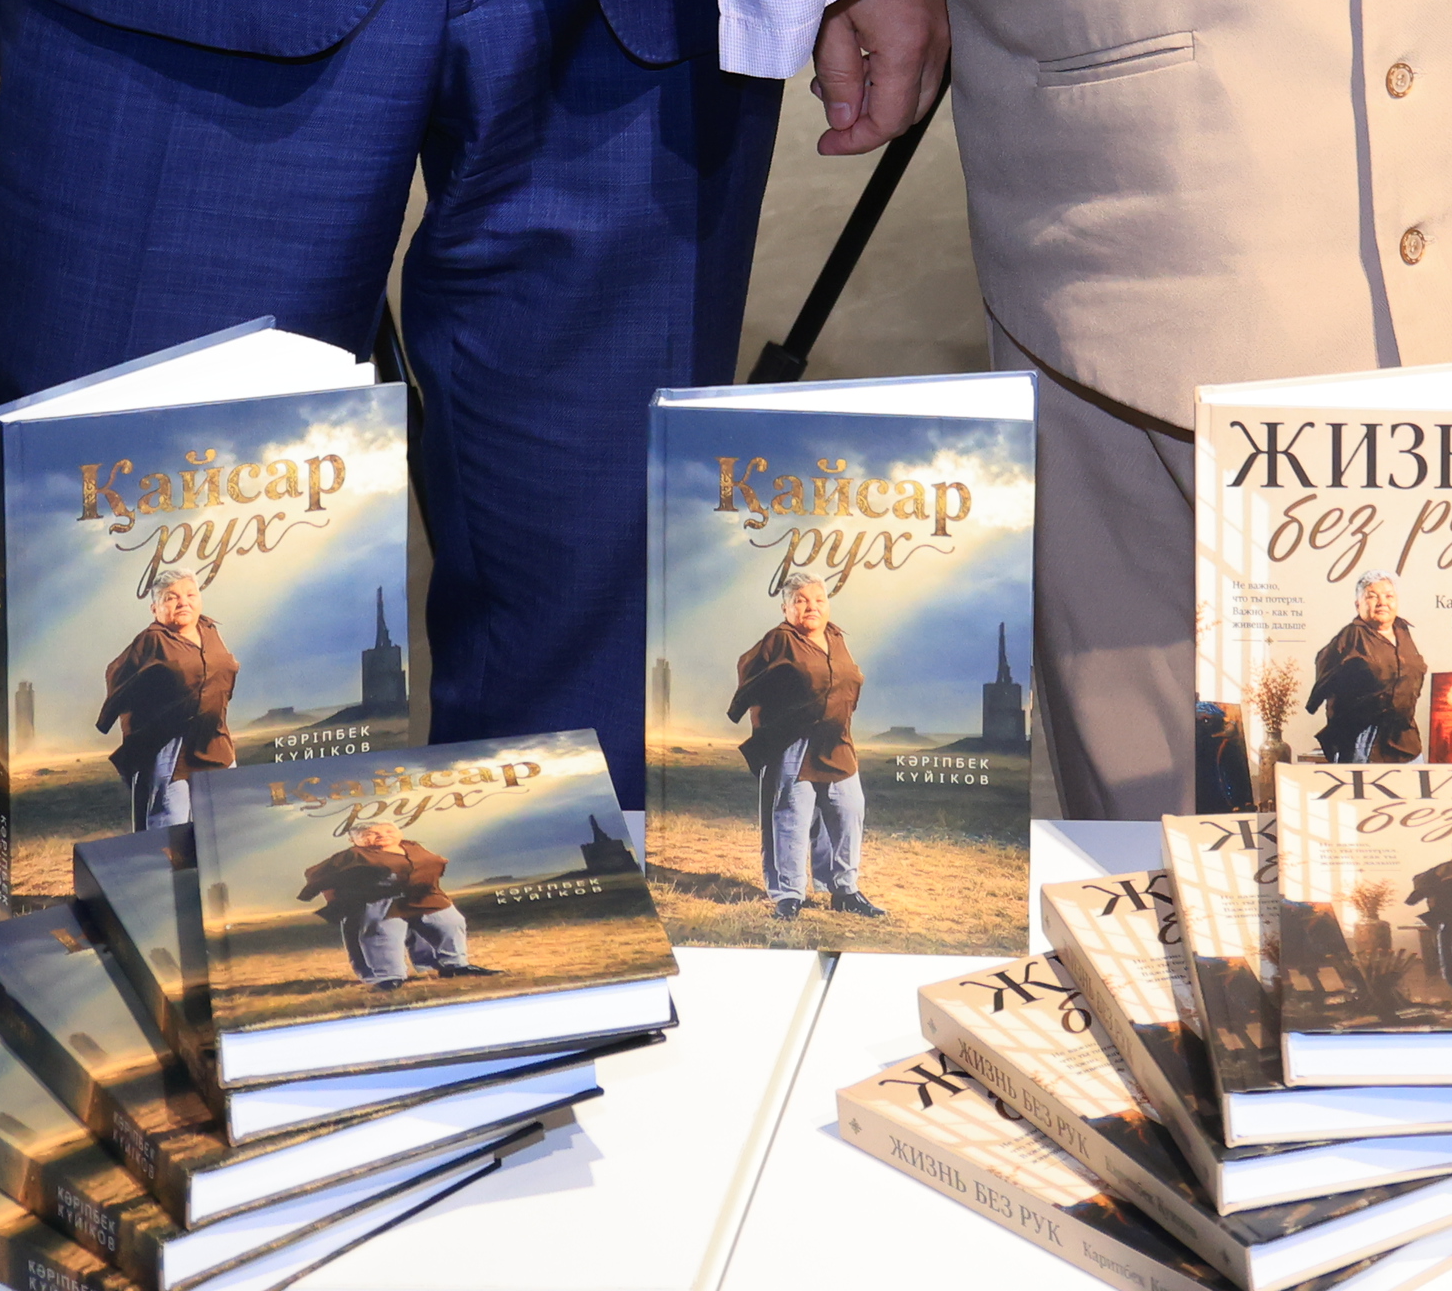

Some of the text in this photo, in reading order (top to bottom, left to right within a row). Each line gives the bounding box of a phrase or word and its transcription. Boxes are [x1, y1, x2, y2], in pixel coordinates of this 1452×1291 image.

[76, 448, 346, 536] Қайсар
[713, 456, 972, 537] Қайсар
[1267, 493, 1384, 583] без
[115, 512, 331, 600] рух
[749, 525, 955, 598] рух
[1232, 580, 1246, 590] Не
[1232, 594, 1305, 606] что ты потерял.
[1232, 606, 1264, 617] Важно
[1271, 608, 1289, 617] как
[1291, 608, 1303, 617] ты
[1232, 620, 1306, 631] живешь дальше
[275, 725, 370, 749] КӘРІПБЕК
[275, 742, 370, 764] КҮЙІКОВ
[896, 754, 990, 770] КӘРІПБЕК
[896, 770, 990, 786] КҮЙІКОВ
[307, 789, 530, 838] рух
[958, 1038, 1017, 1100] ЖИЗНЬ
[1021, 1087, 1053, 1128] БЕЗ
[1057, 1116, 1090, 1160] РУК
[889, 1135, 967, 1194] ЖИЗНЬ
[973, 1179, 1013, 1218] БЕЗ
[1018, 1203, 1064, 1248] РУК
[28, 1260, 94, 1291] КӘРІПБ
